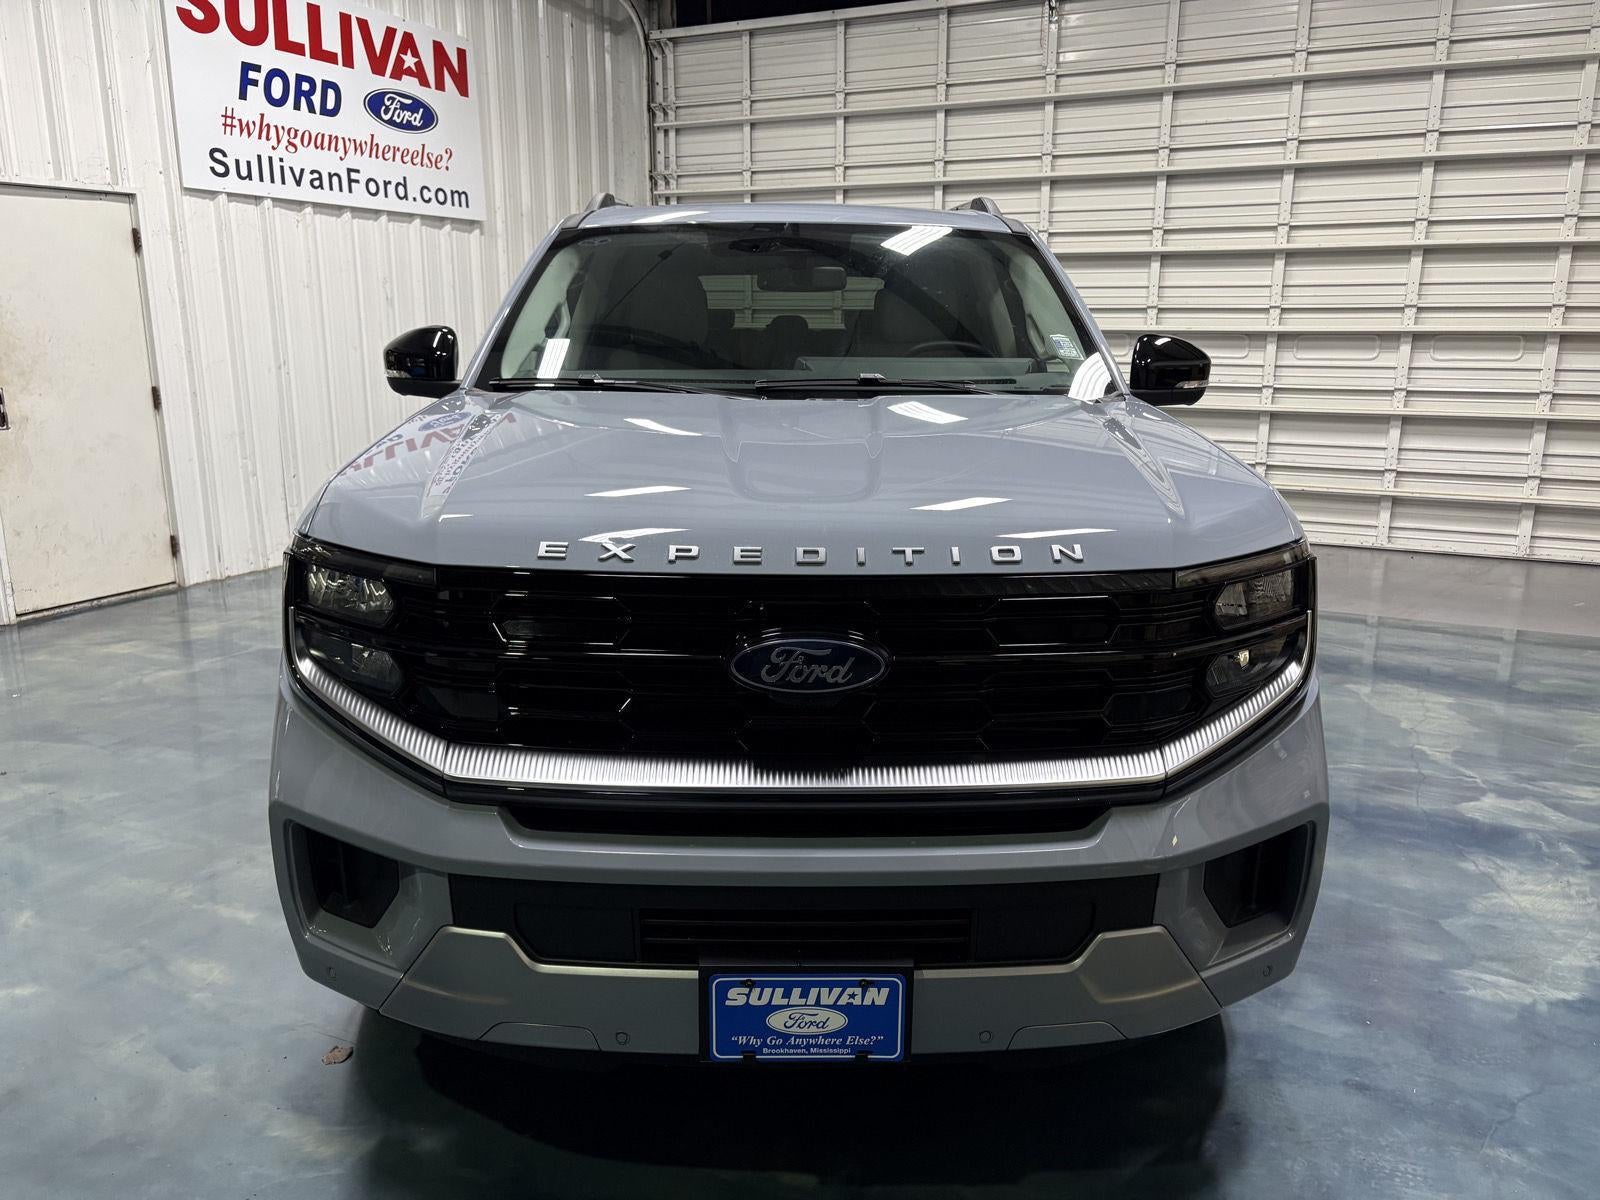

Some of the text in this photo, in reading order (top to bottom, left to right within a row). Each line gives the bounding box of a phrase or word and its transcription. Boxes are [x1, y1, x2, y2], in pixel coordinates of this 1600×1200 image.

[238, 61, 342, 118] FORD
[380, 93, 424, 128] Ford
[220, 106, 453, 172] #whygoanywhereelse?
[208, 147, 470, 209] SullivanFord.com
[537, 541, 1085, 566] EXPEDITION
[760, 646, 853, 685] Ford
[725, 987, 889, 1006] SULLIVAN
[783, 1012, 830, 1030] Ford
[731, 1035, 884, 1046] “Why Go Anywhere Else?”
[762, 1047, 851, 1055] Brookhaven, Mississippi
